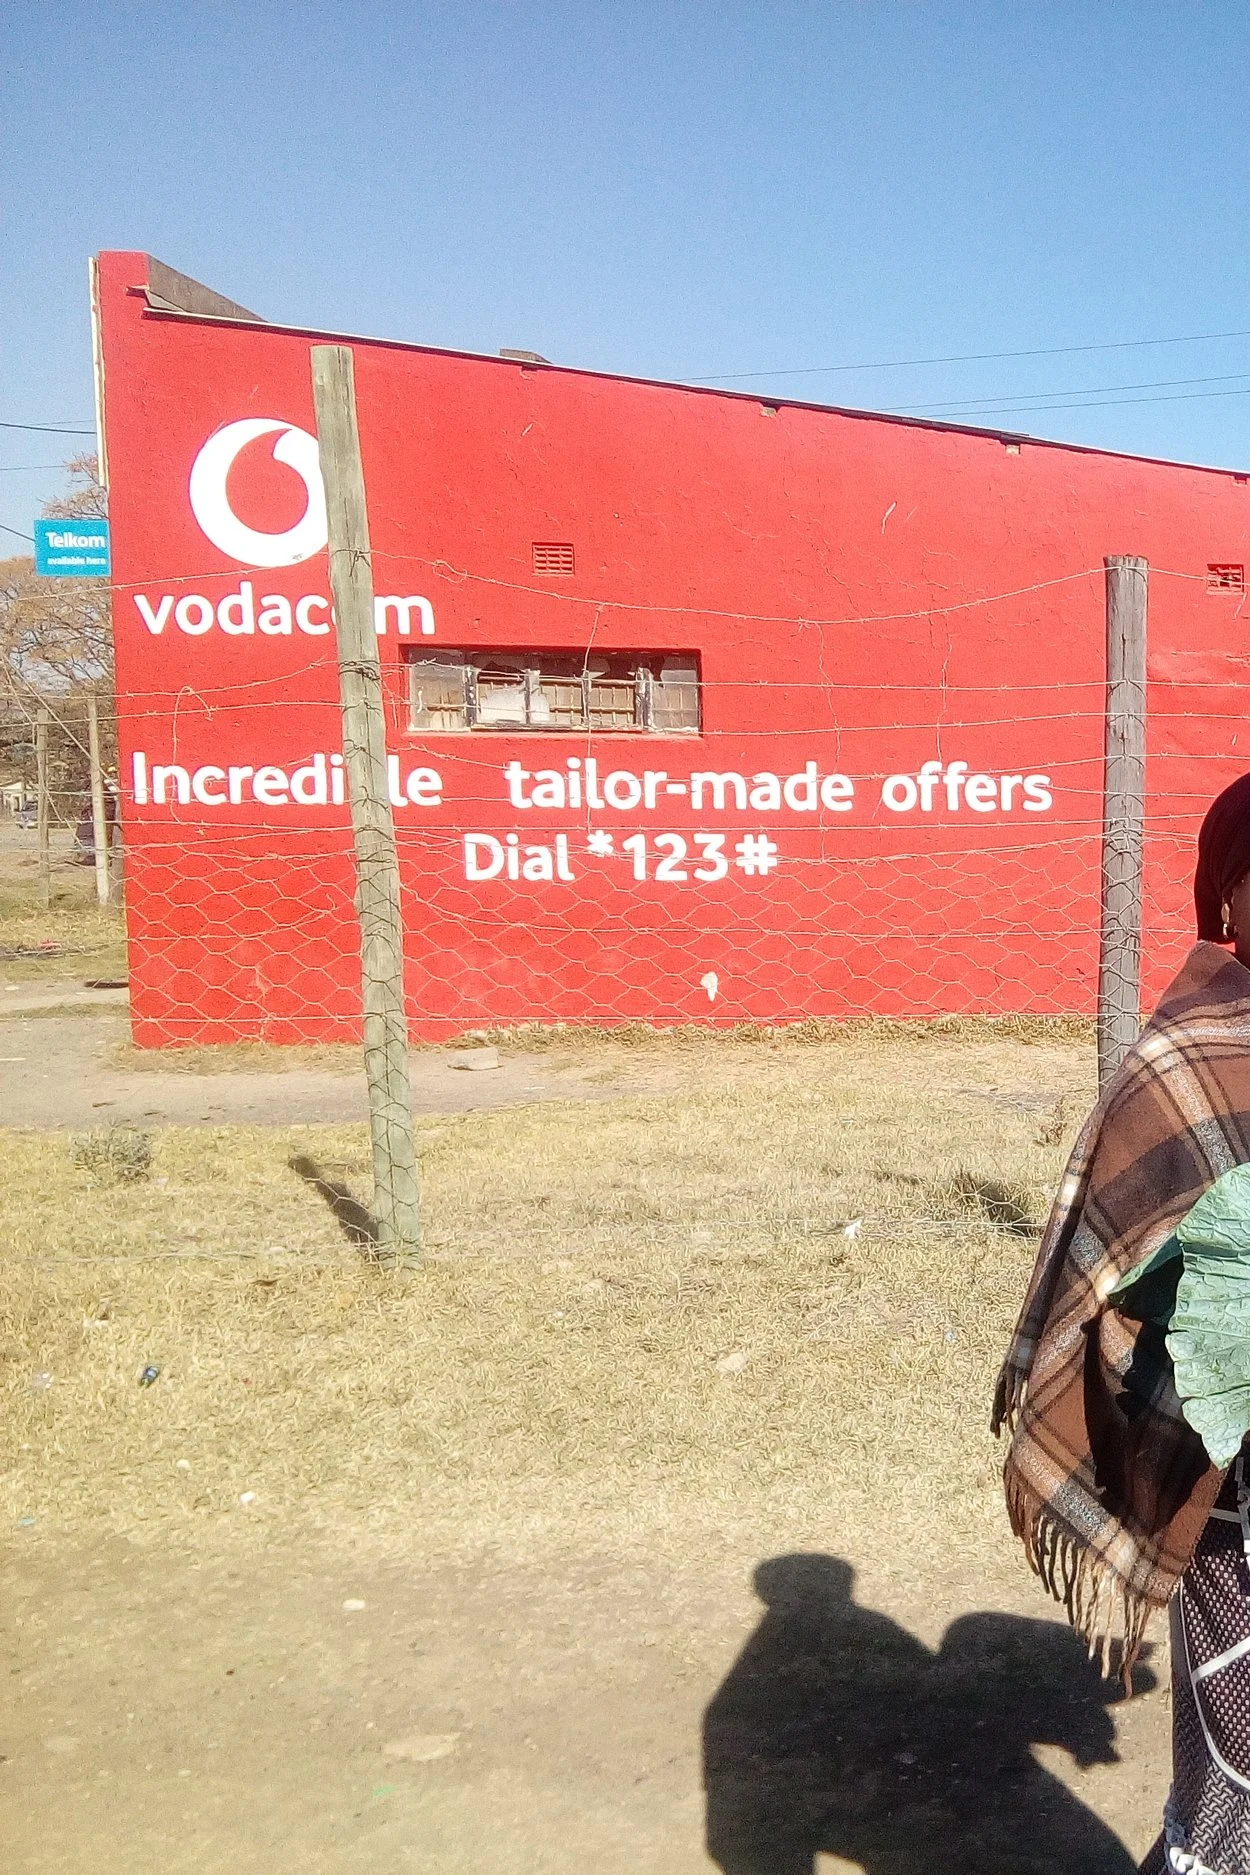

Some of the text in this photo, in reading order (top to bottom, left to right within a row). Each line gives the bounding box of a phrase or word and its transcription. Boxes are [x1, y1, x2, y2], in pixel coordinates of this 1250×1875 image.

[45, 531, 106, 548] Telkom
[133, 580, 435, 636] vodacm
[132, 751, 1053, 812] Incredile tailor-made offers
[463, 832, 575, 881] Dial
